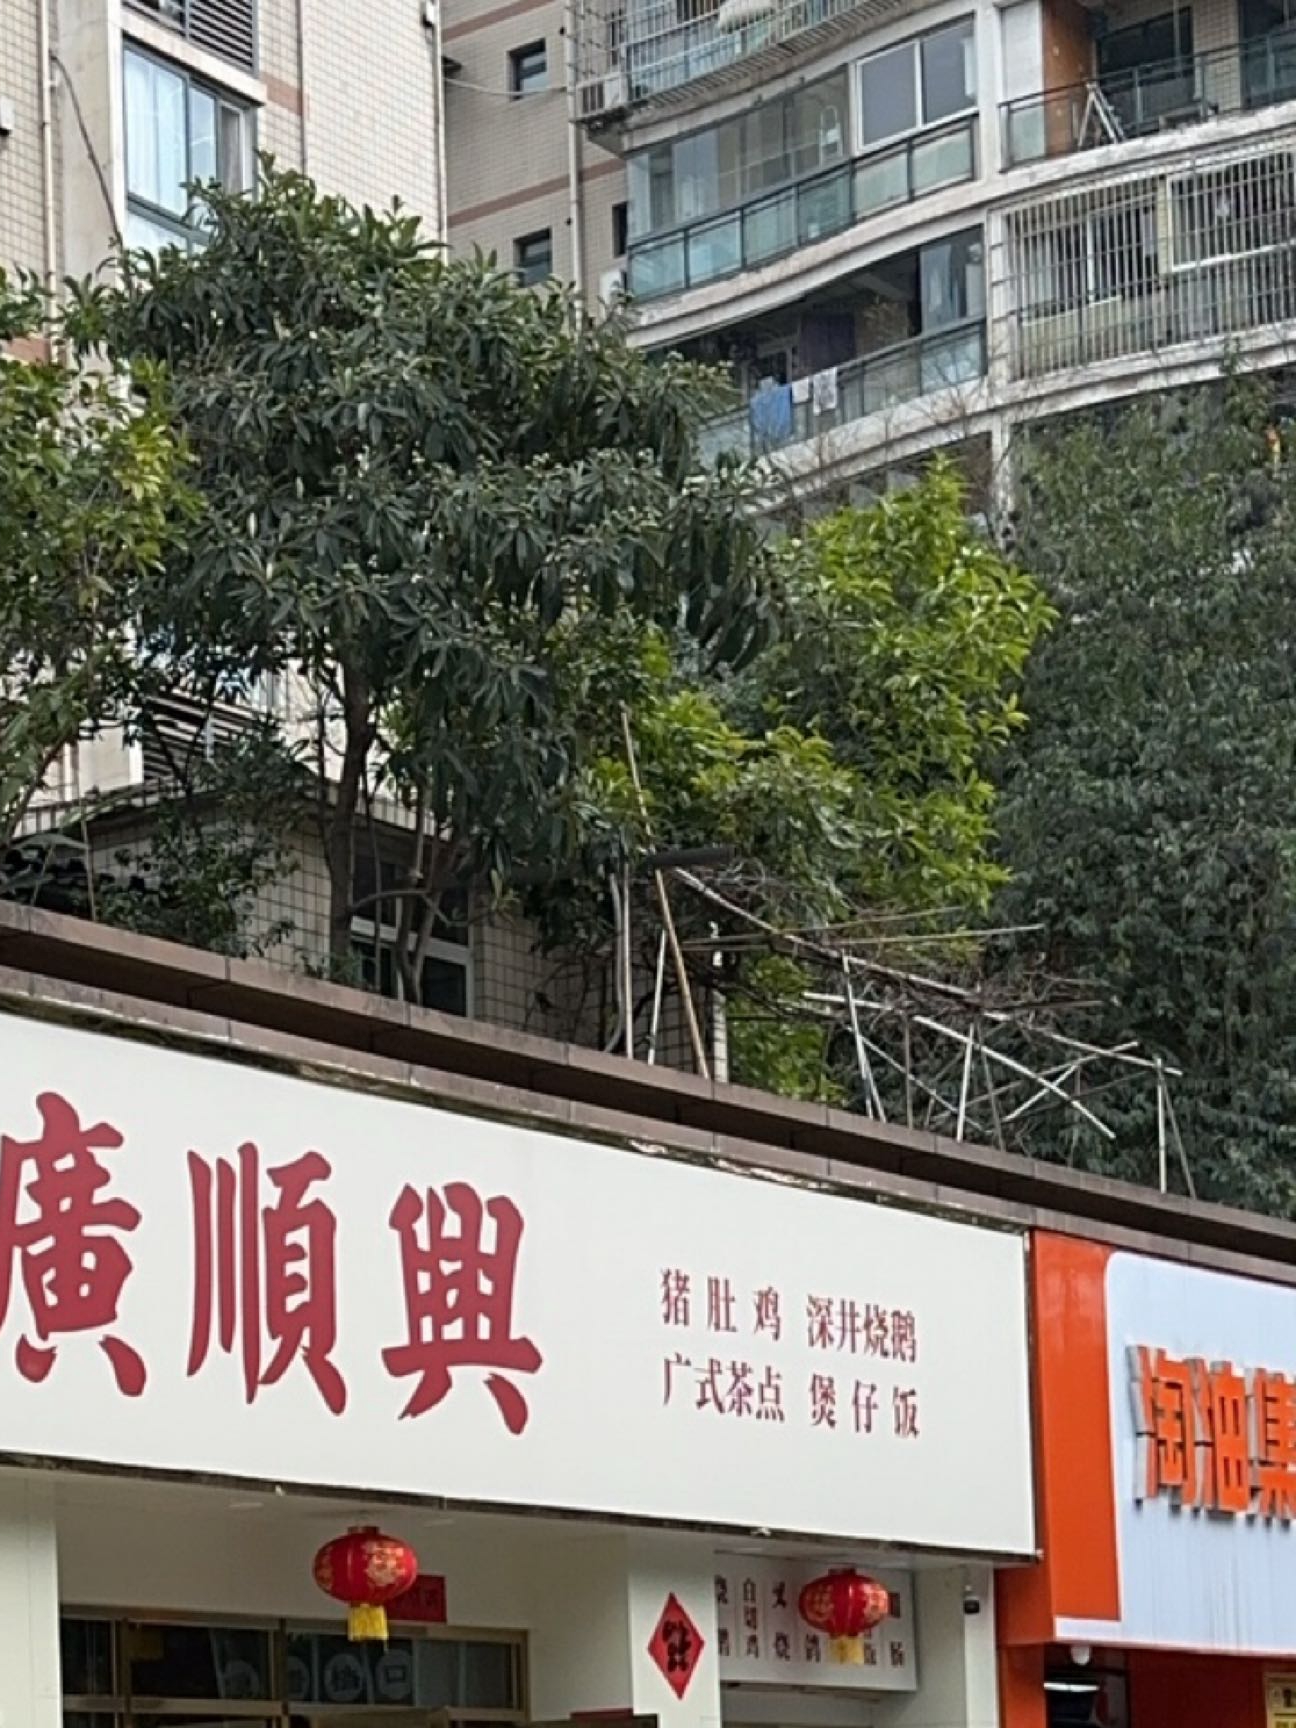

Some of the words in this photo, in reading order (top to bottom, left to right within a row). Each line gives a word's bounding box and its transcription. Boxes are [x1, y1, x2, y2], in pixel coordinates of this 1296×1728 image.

[806, 1294, 917, 1364] 深井烧鹅
[662, 1352, 785, 1423] 广式茶点
[808, 1372, 921, 1440] 煲仔饭
